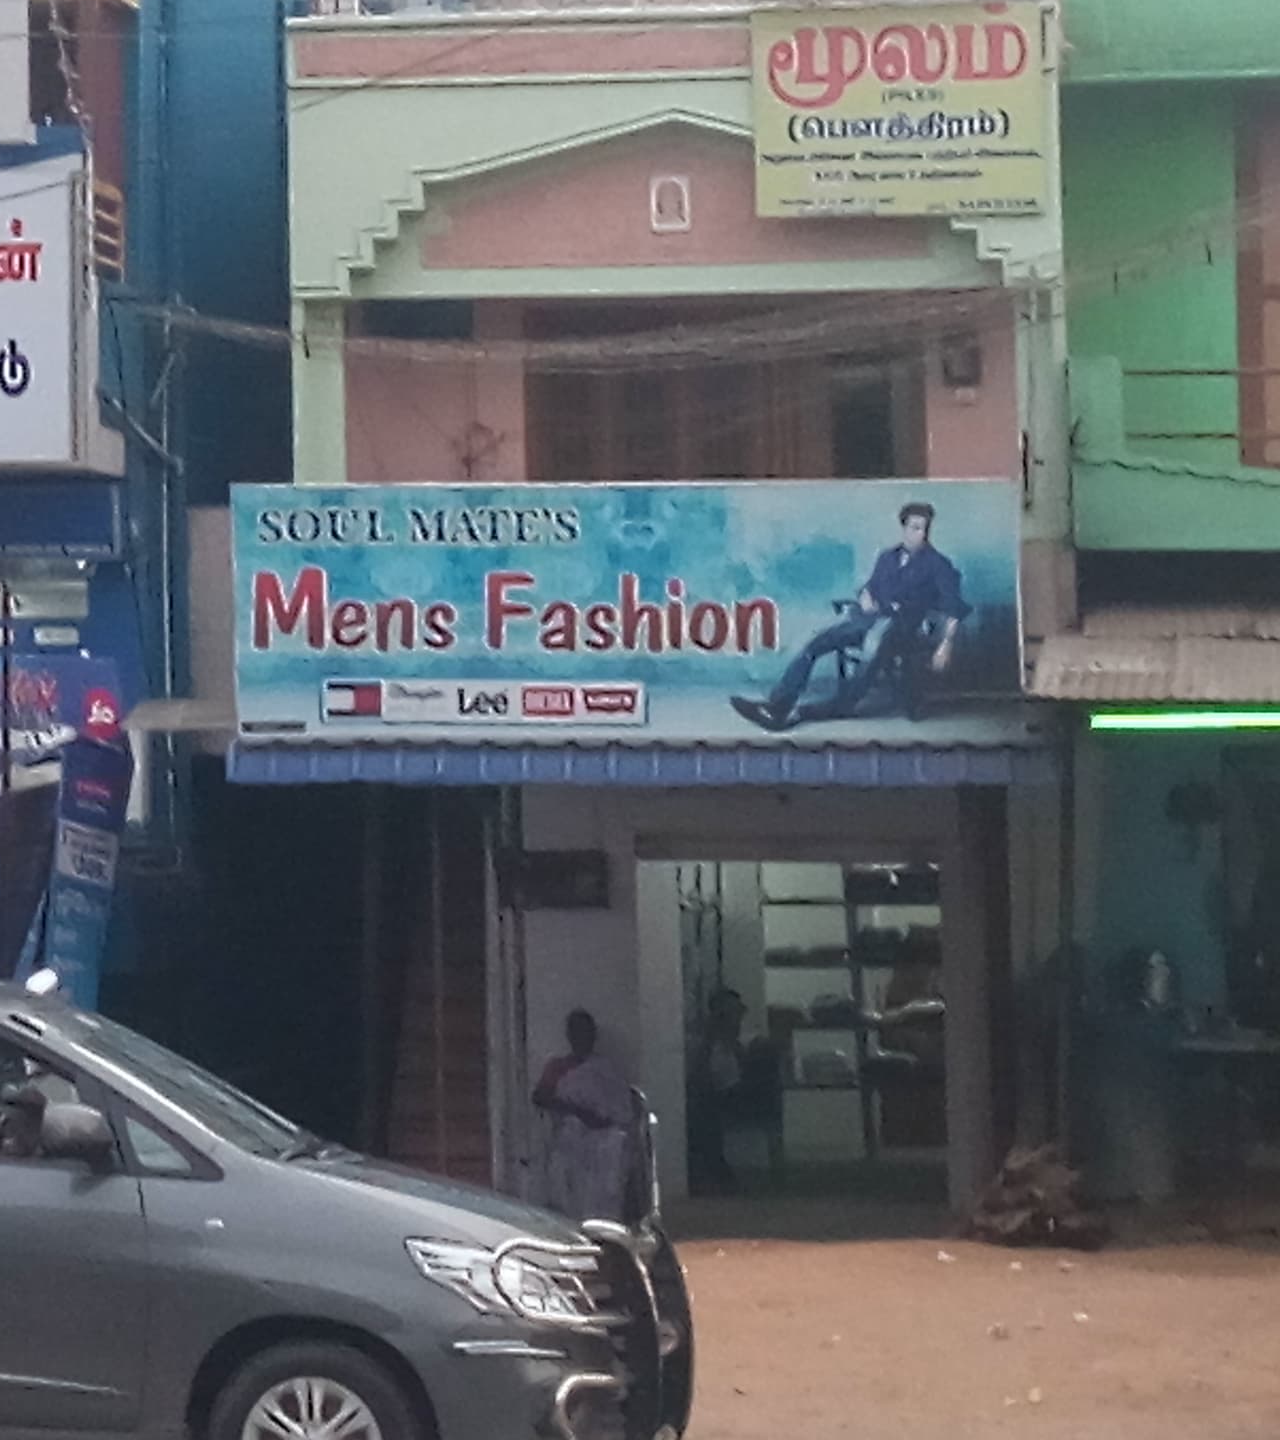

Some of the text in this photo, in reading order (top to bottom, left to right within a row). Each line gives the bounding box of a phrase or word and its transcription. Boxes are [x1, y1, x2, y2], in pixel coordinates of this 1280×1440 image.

[767, 1, 1029, 109] மூலம்
[407, 506, 581, 546] MATE'S
[250, 566, 780, 653] Mens Fashion
[457, 686, 509, 717] Lee
